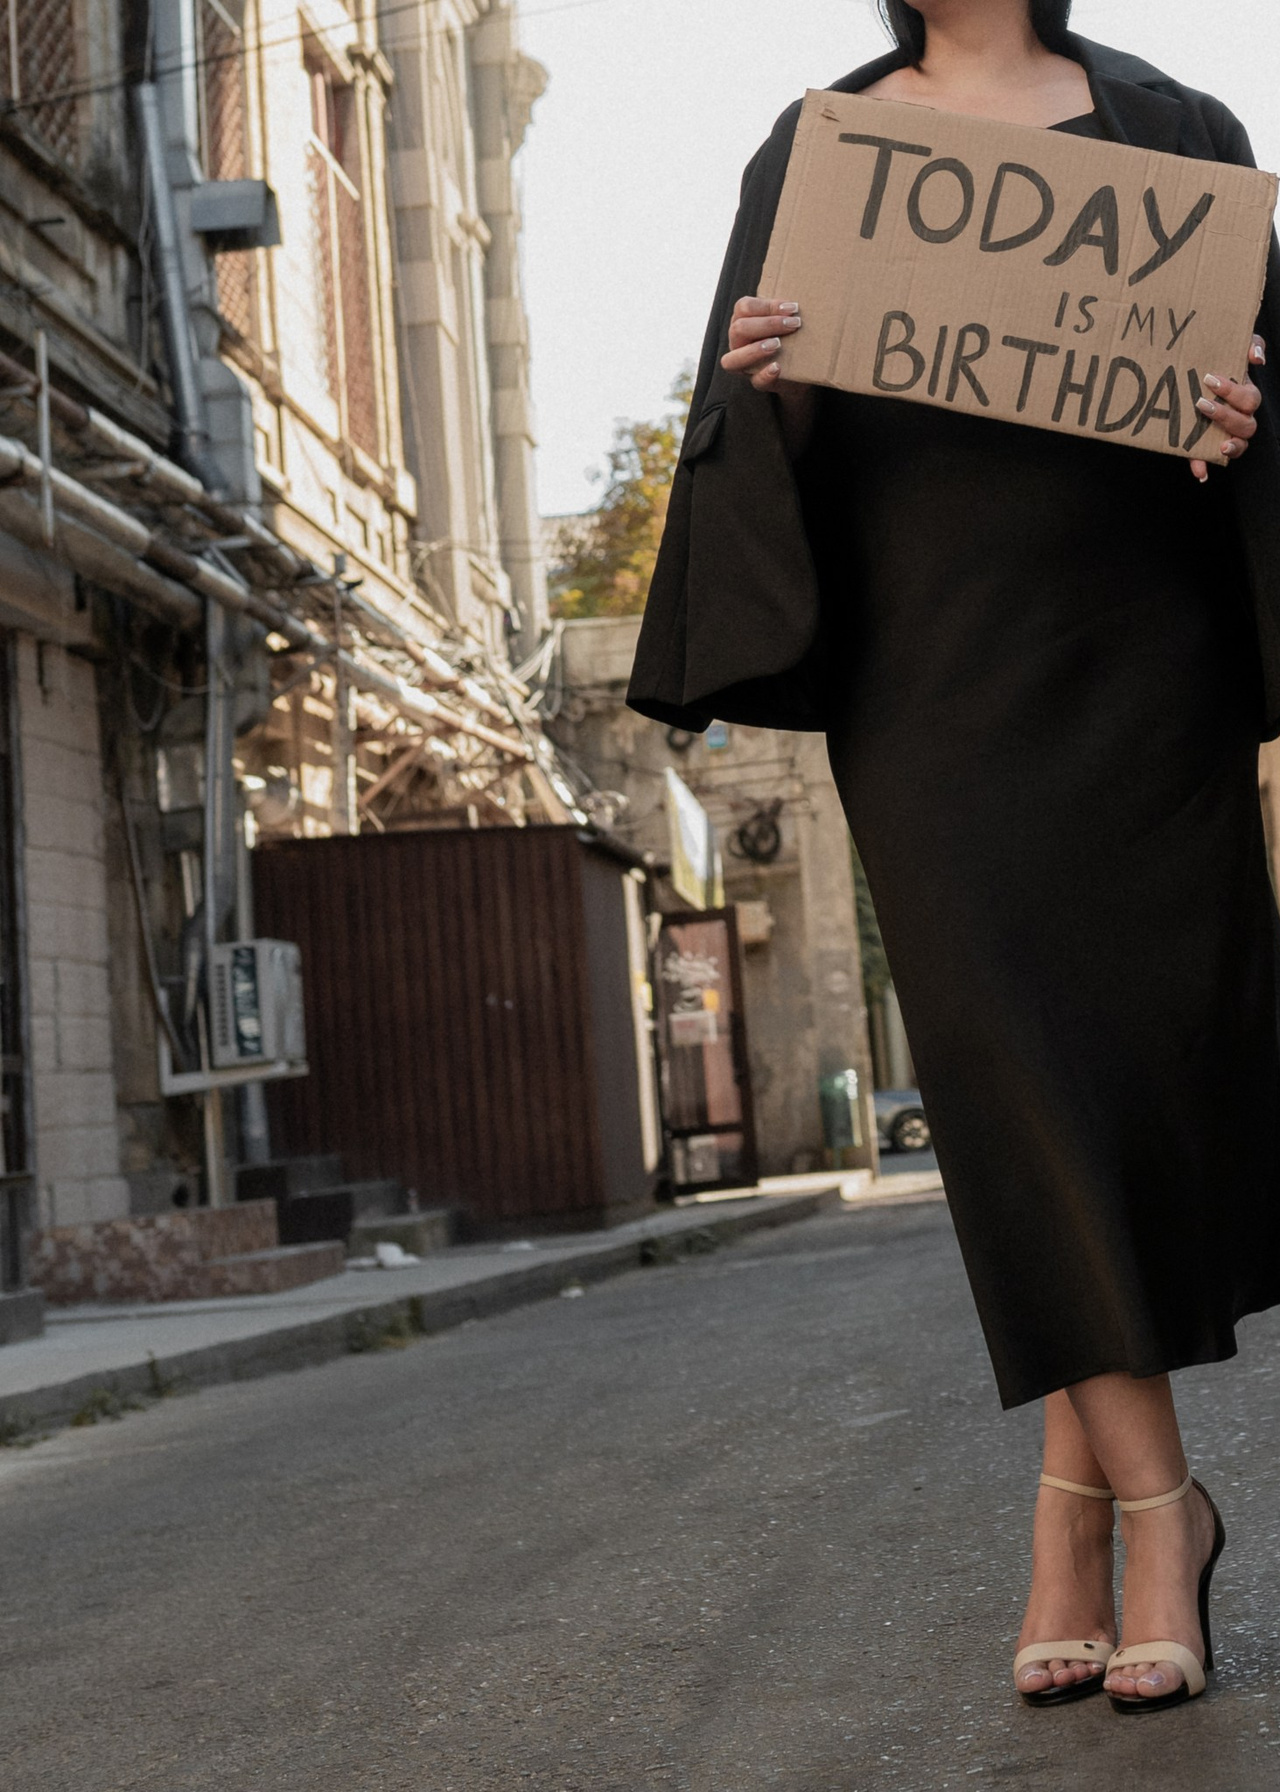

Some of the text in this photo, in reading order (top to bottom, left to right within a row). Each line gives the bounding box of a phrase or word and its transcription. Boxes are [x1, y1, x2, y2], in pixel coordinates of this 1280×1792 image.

[838, 132, 1216, 287] TODAY
[872, 310, 1238, 452] BIRTHDAY
[1053, 291, 1197, 351] IS MY
